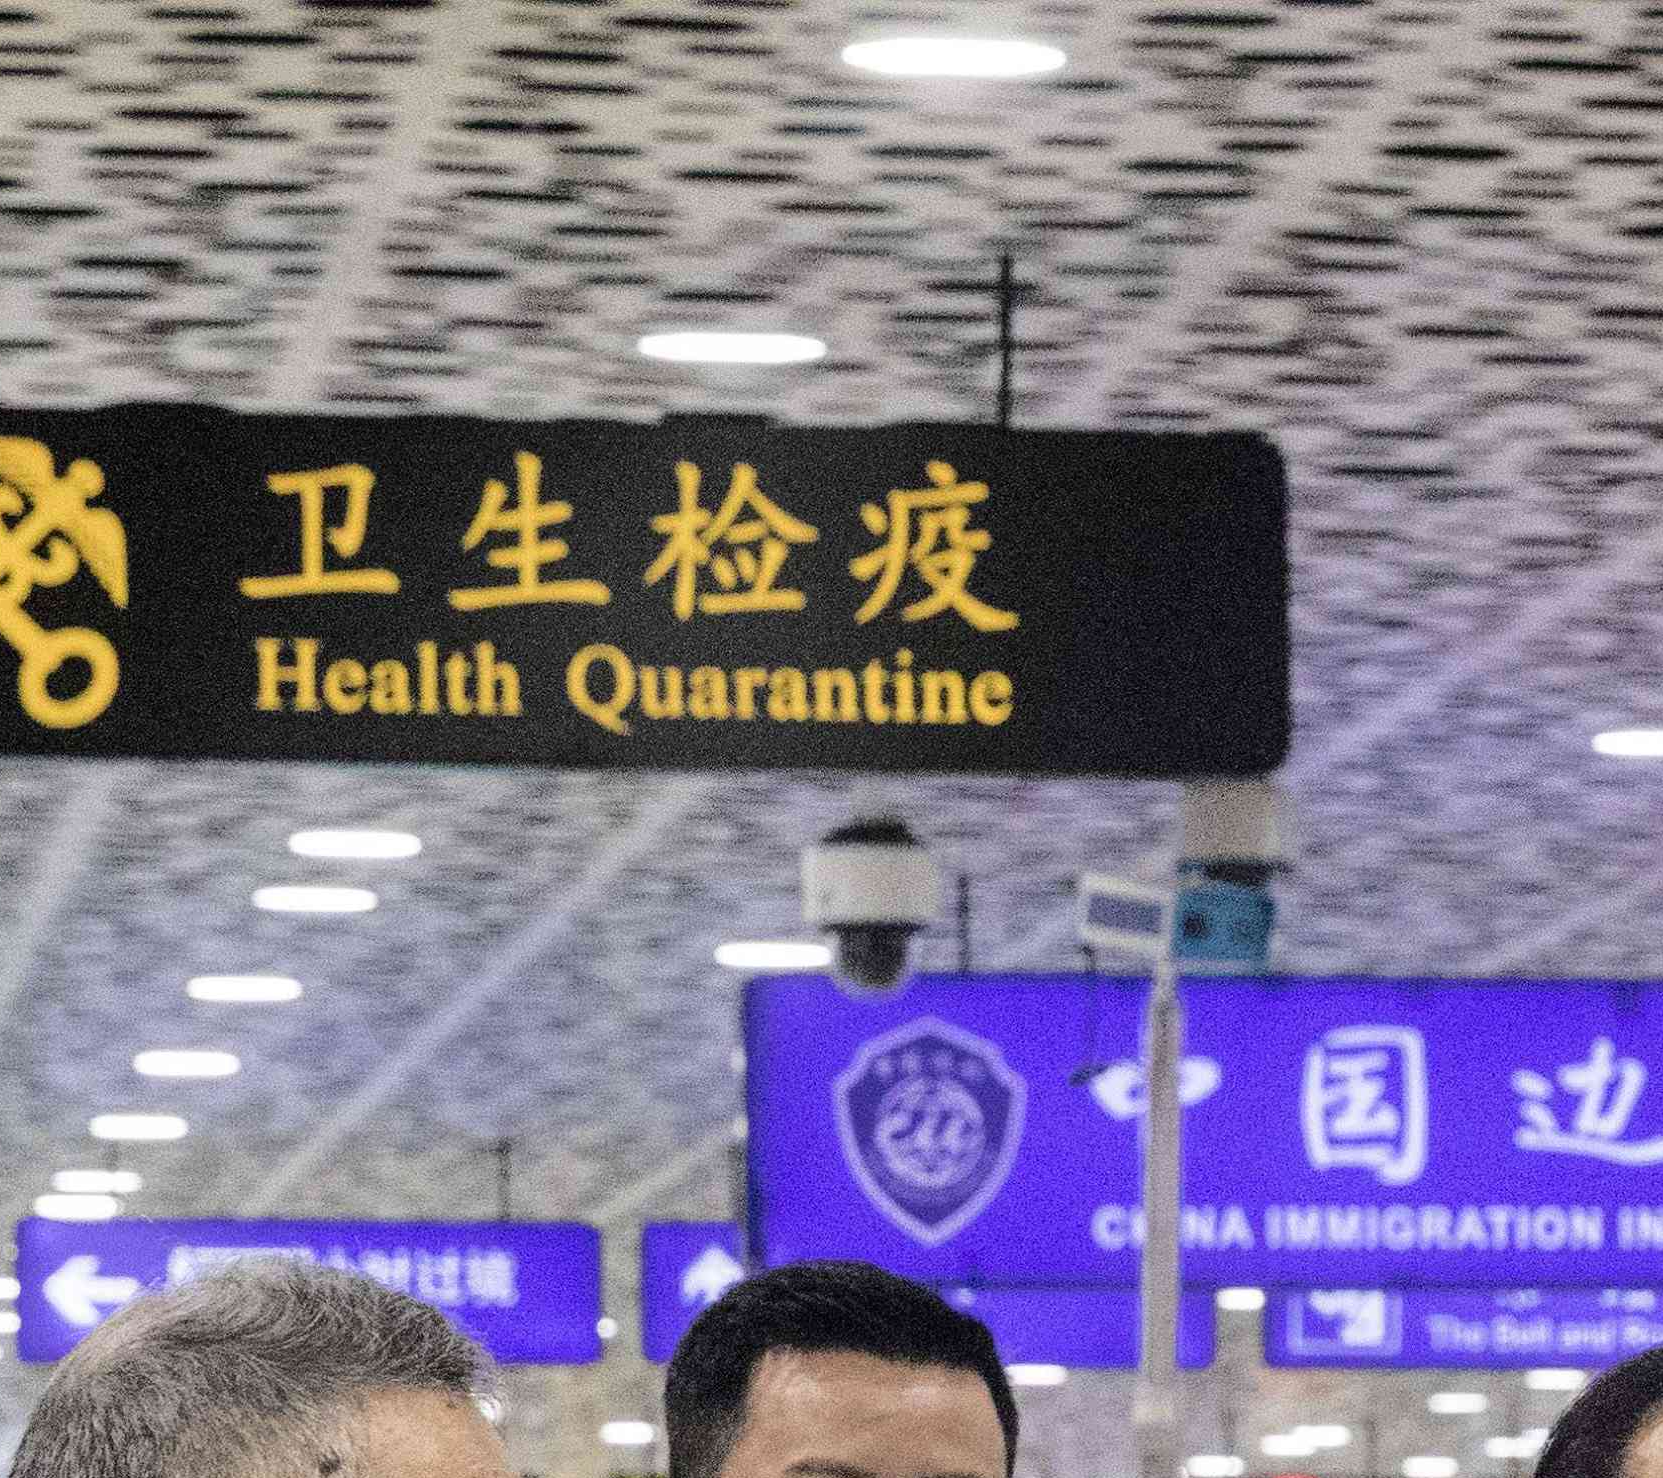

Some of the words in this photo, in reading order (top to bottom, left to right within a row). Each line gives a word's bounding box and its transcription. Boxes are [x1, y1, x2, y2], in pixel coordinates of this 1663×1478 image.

[239, 452, 1018, 633] 卫生检疫
[256, 638, 521, 716] Health
[566, 641, 1013, 734] Quarantine
[1092, 1204, 1255, 1253] CNA
[1265, 1205, 1603, 1253] IMMIGRATION
